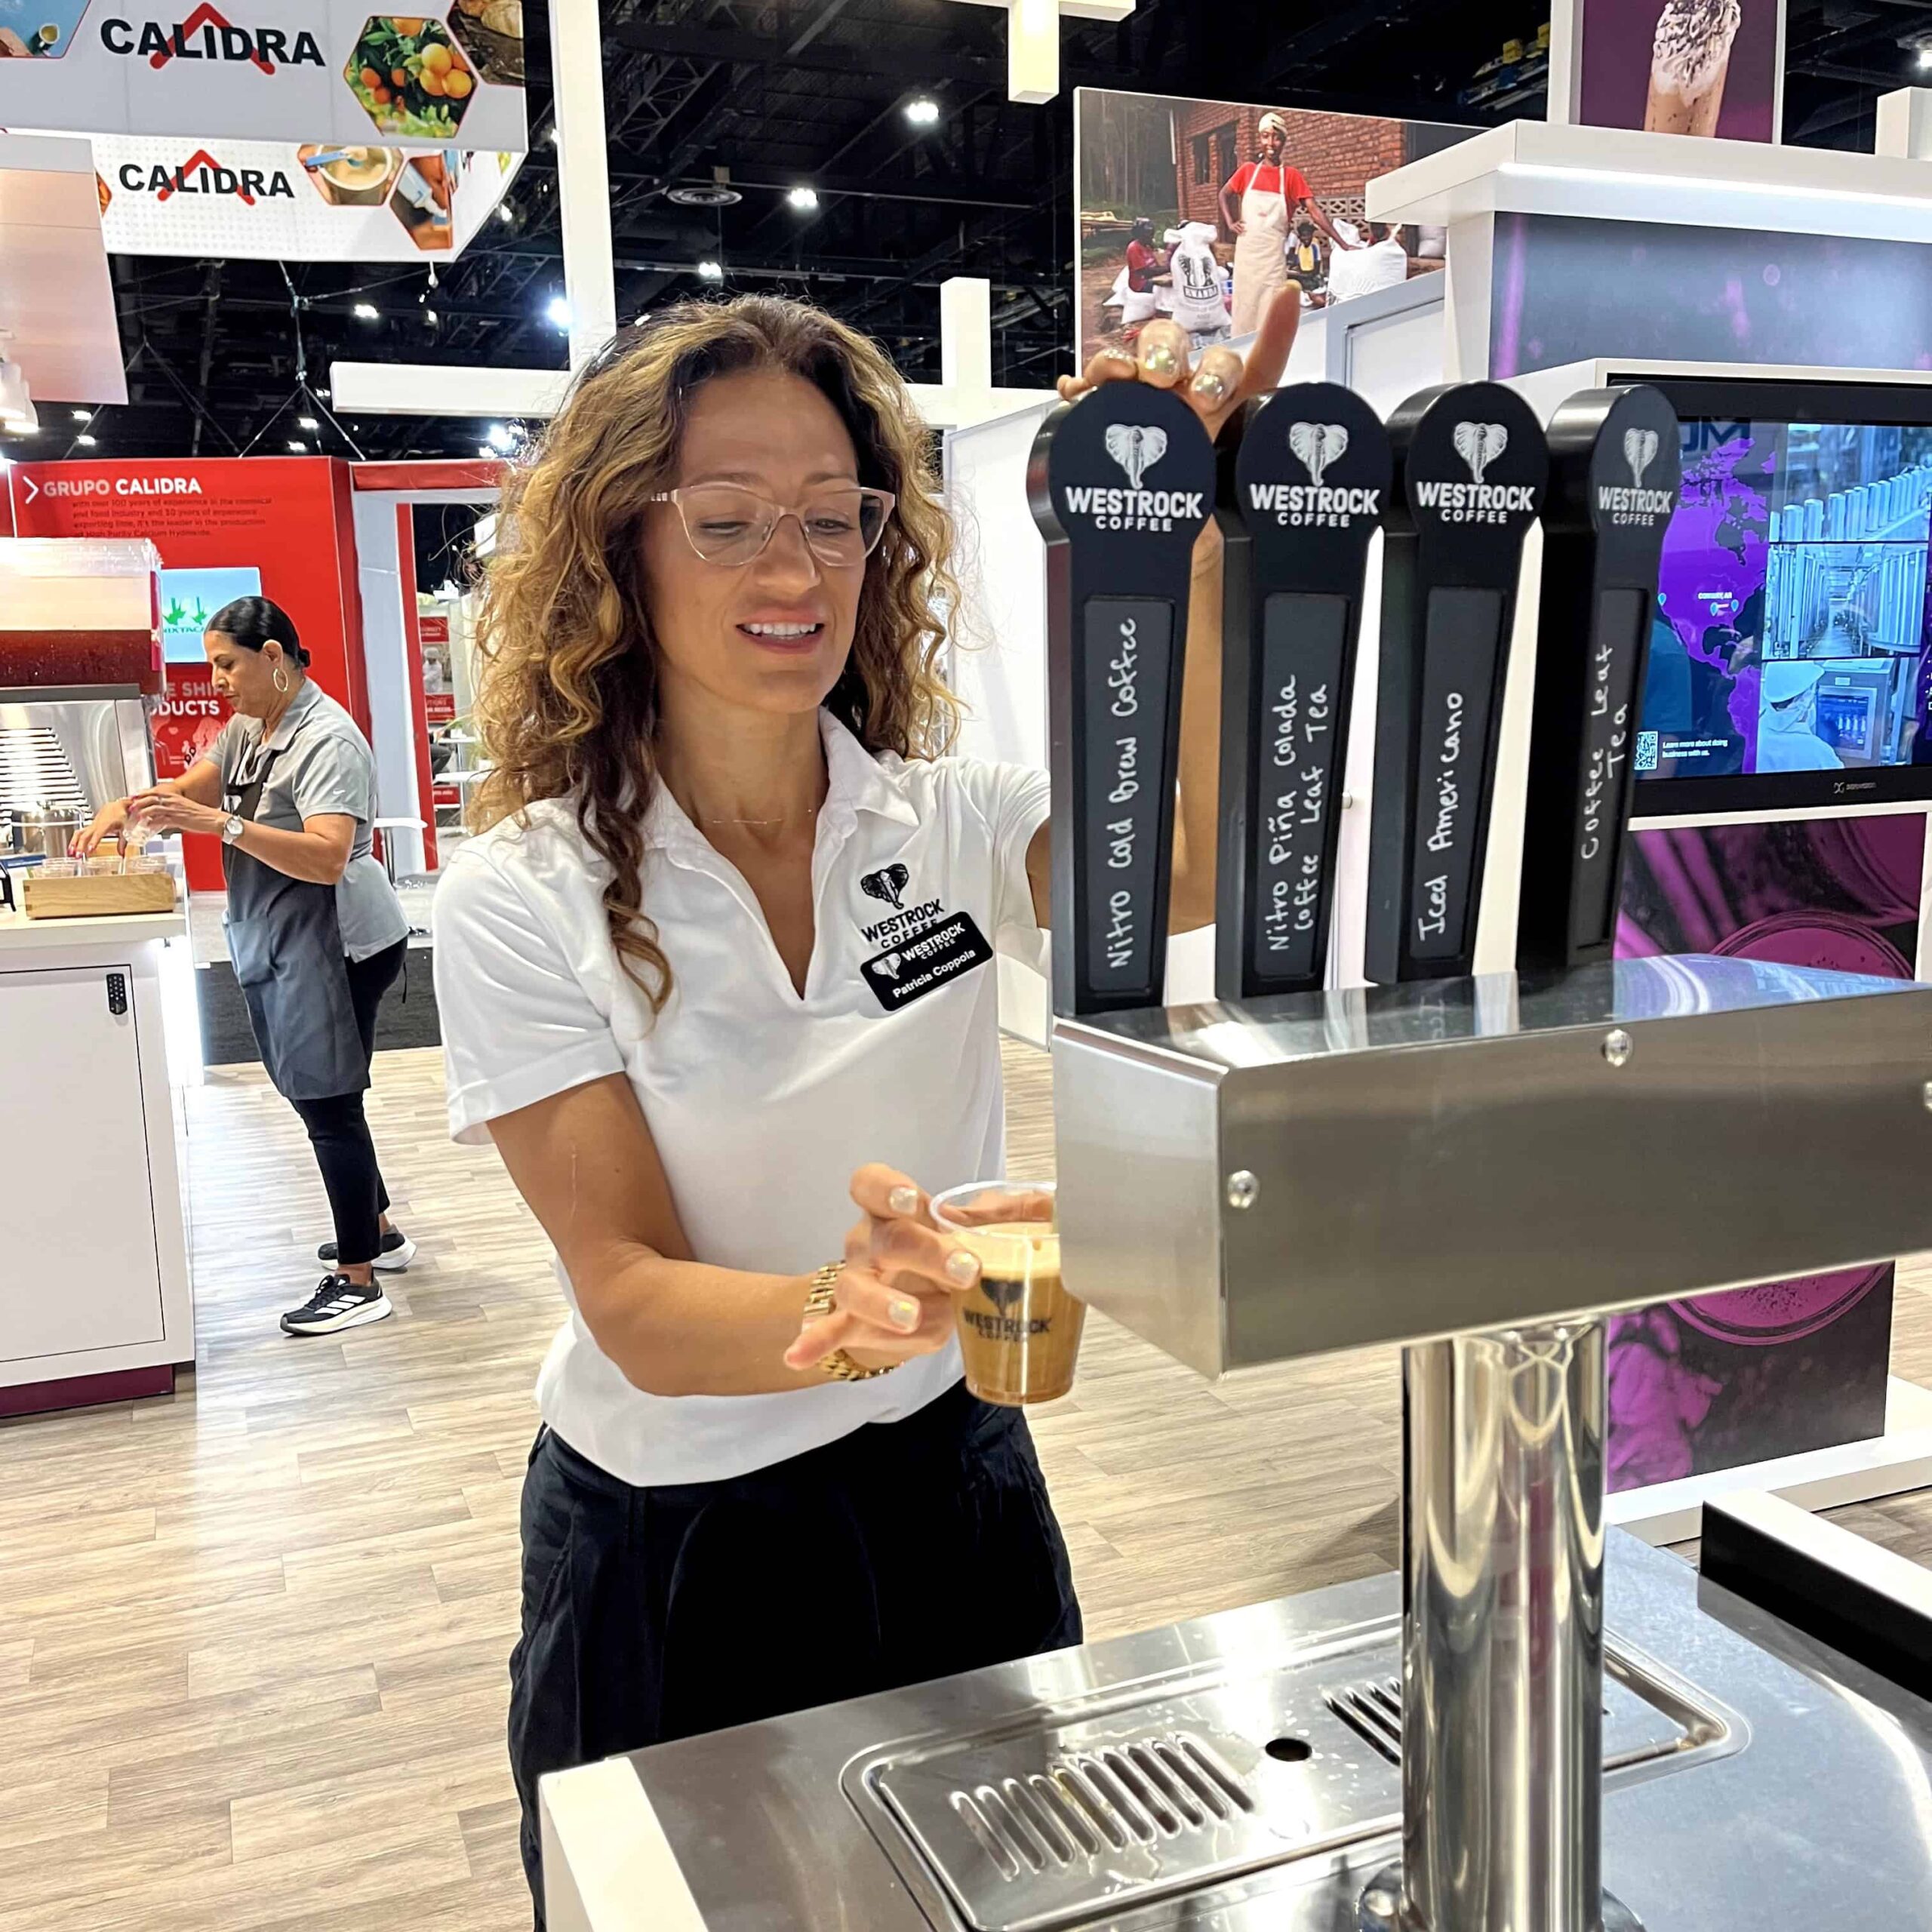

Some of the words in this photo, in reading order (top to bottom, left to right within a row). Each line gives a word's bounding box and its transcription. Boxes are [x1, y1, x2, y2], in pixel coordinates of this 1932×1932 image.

[100, 18, 326, 67] CALIDRA
[118, 163, 295, 198] CALIDRA
[43, 478, 110, 497] GRUPO
[115, 477, 202, 495] CALIDRA
[1065, 486, 1204, 519] WESTROCK
[1250, 483, 1380, 515] WESTROCK
[1416, 481, 1536, 512] WESTROCK
[1598, 485, 1673, 513] WESTROCK
[1094, 515, 1173, 533] COFFEE
[1277, 511, 1350, 528] COFFEE
[1441, 509, 1508, 524] COFFEE
[1612, 512, 1654, 526] COFFEE
[1107, 617, 1138, 718] Coffee
[1590, 644, 1613, 716] Leaf
[150, 700, 220, 716] DUCTS
[1272, 673, 1298, 767] Colada
[1306, 683, 1328, 743] Tea
[1607, 703, 1628, 779] Tea
[1107, 736, 1140, 804] Brew
[1300, 765, 1324, 825] Leaf
[1426, 691, 1464, 853] Americano
[1268, 789, 1297, 866] Piña
[1581, 748, 1604, 859] Coffee
[1106, 817, 1133, 869] Cold
[1266, 880, 1289, 951] Nitro
[1294, 854, 1319, 931] Coffee
[1417, 874, 1449, 942] Iced
[861, 899, 944, 942] WESTROCK
[901, 921, 966, 961] WESTROCK
[1106, 889, 1133, 969] Nitro
[892, 973, 934, 998] Patricia
[932, 949, 977, 976] Coppola
